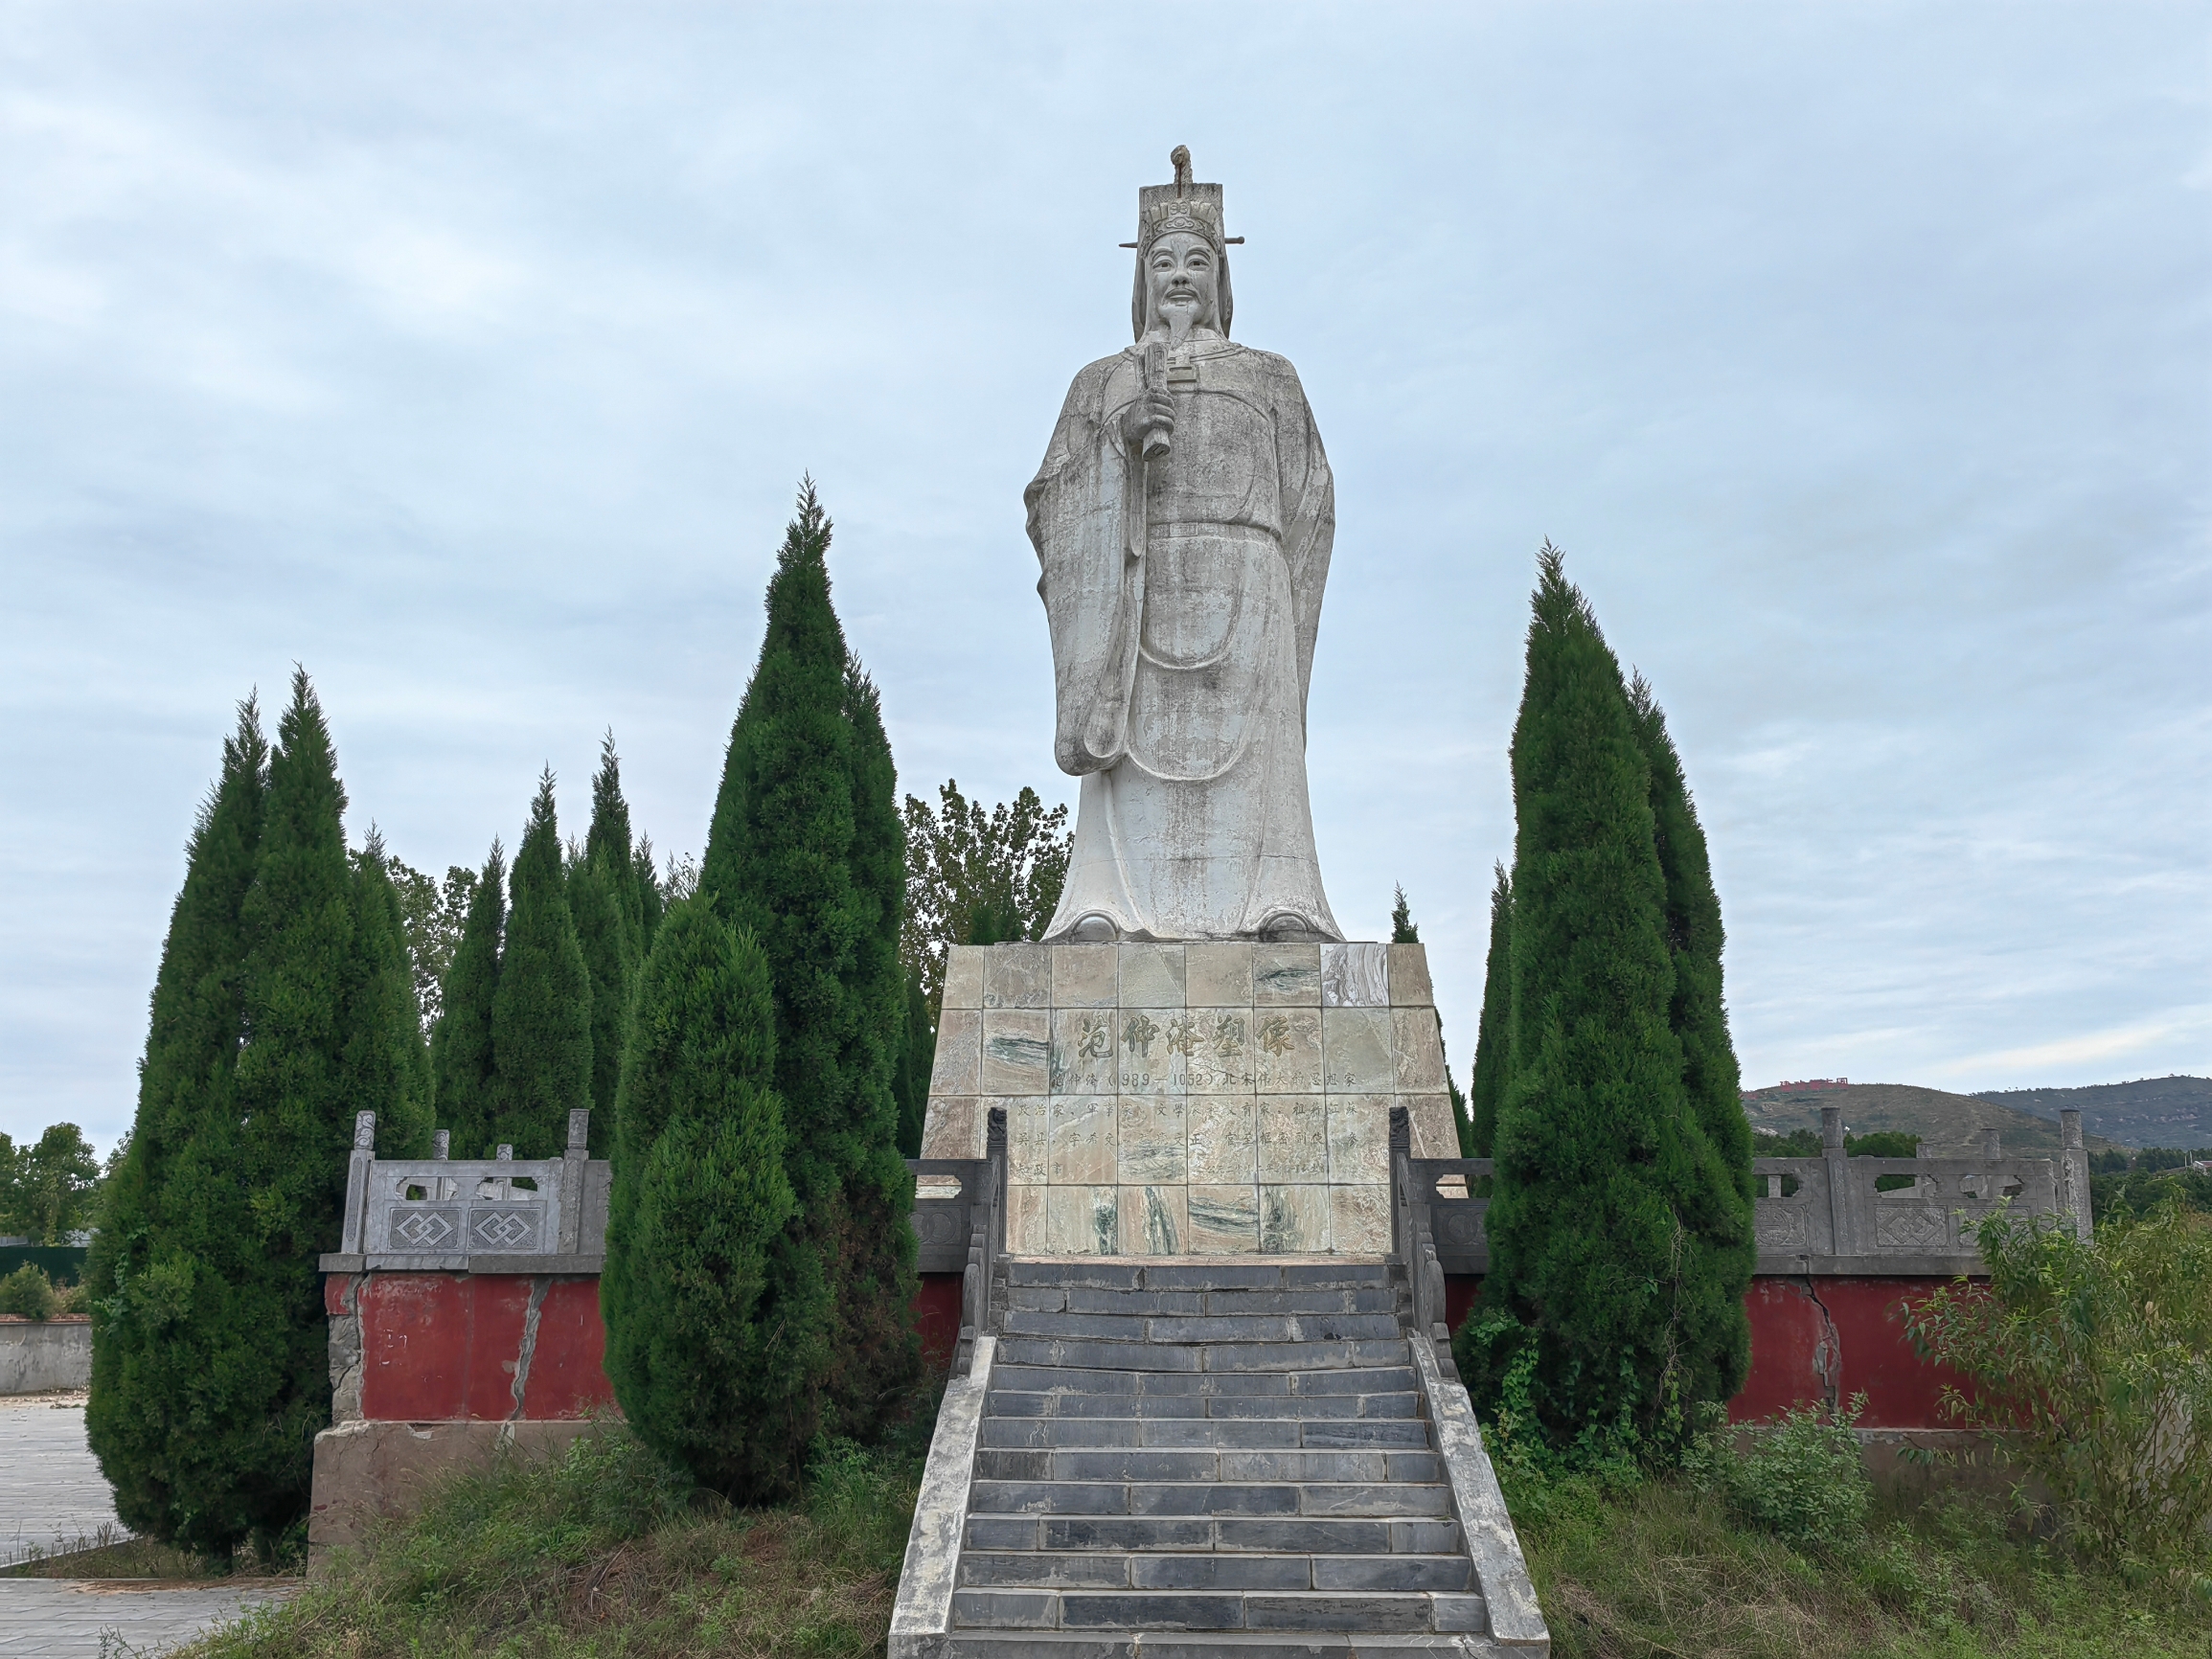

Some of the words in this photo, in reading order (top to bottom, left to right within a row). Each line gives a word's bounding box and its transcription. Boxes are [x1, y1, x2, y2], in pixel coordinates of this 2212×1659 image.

[1077, 1014, 1295, 1058] 范仲淹塑像
